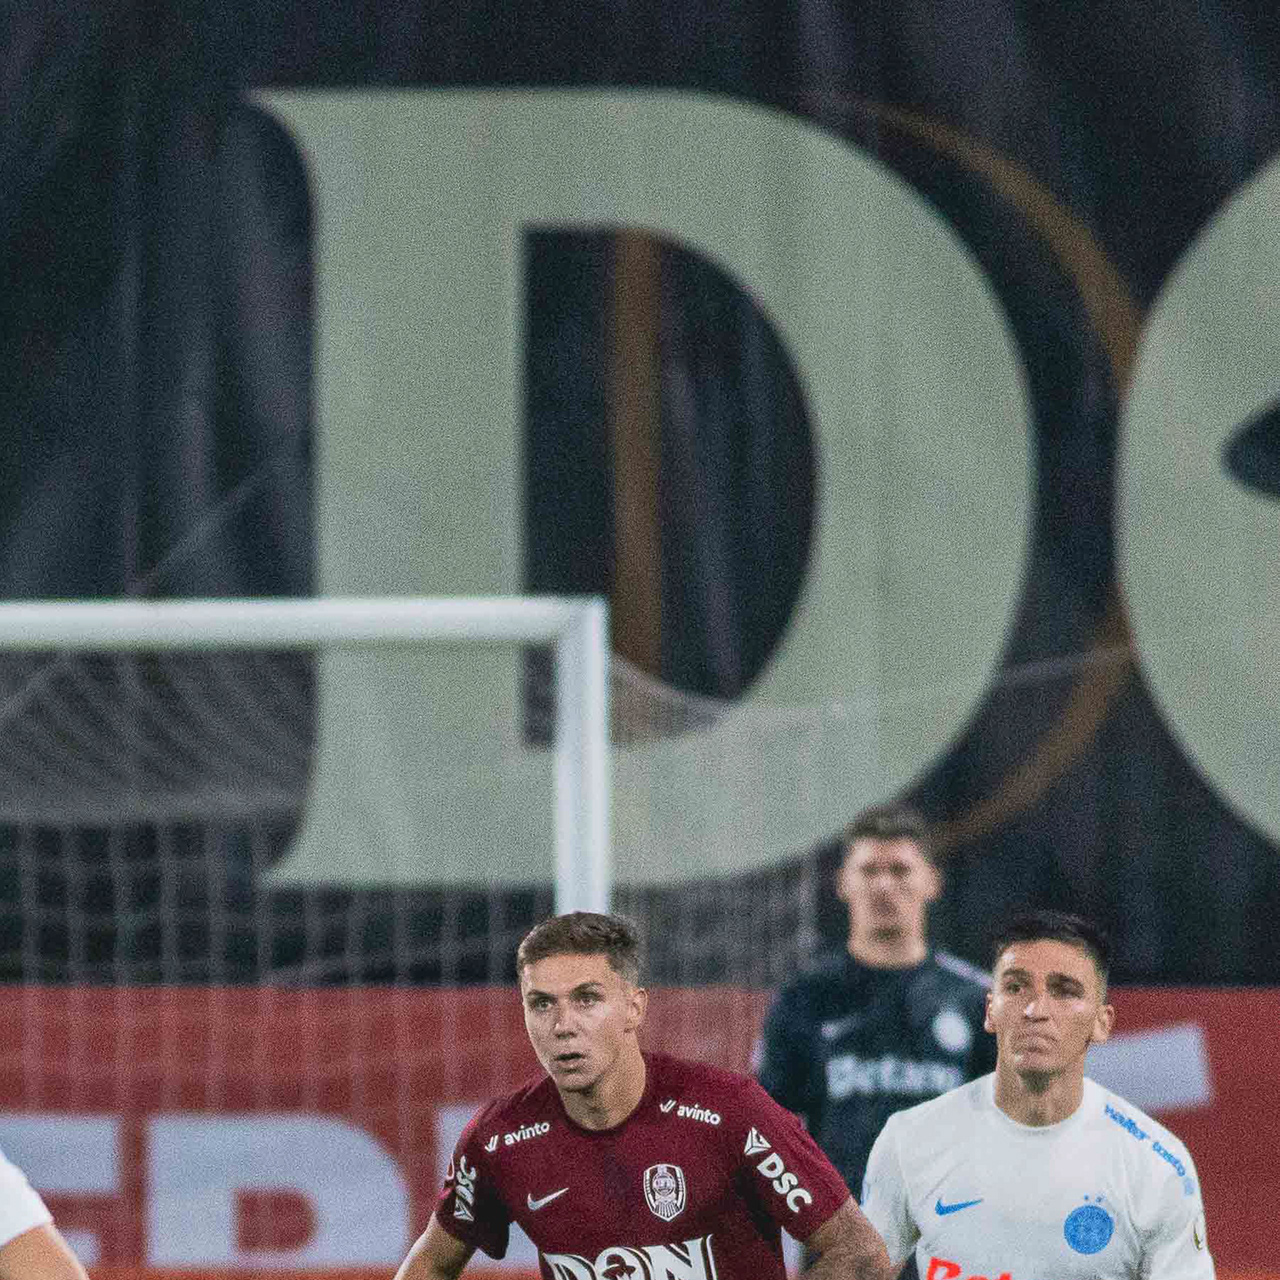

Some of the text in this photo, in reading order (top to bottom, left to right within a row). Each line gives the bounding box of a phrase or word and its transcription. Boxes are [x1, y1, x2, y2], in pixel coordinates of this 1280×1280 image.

[677, 1103, 721, 1126] avinto
[504, 1121, 550, 1146] avinto
[757, 1152, 813, 1214] DSC
